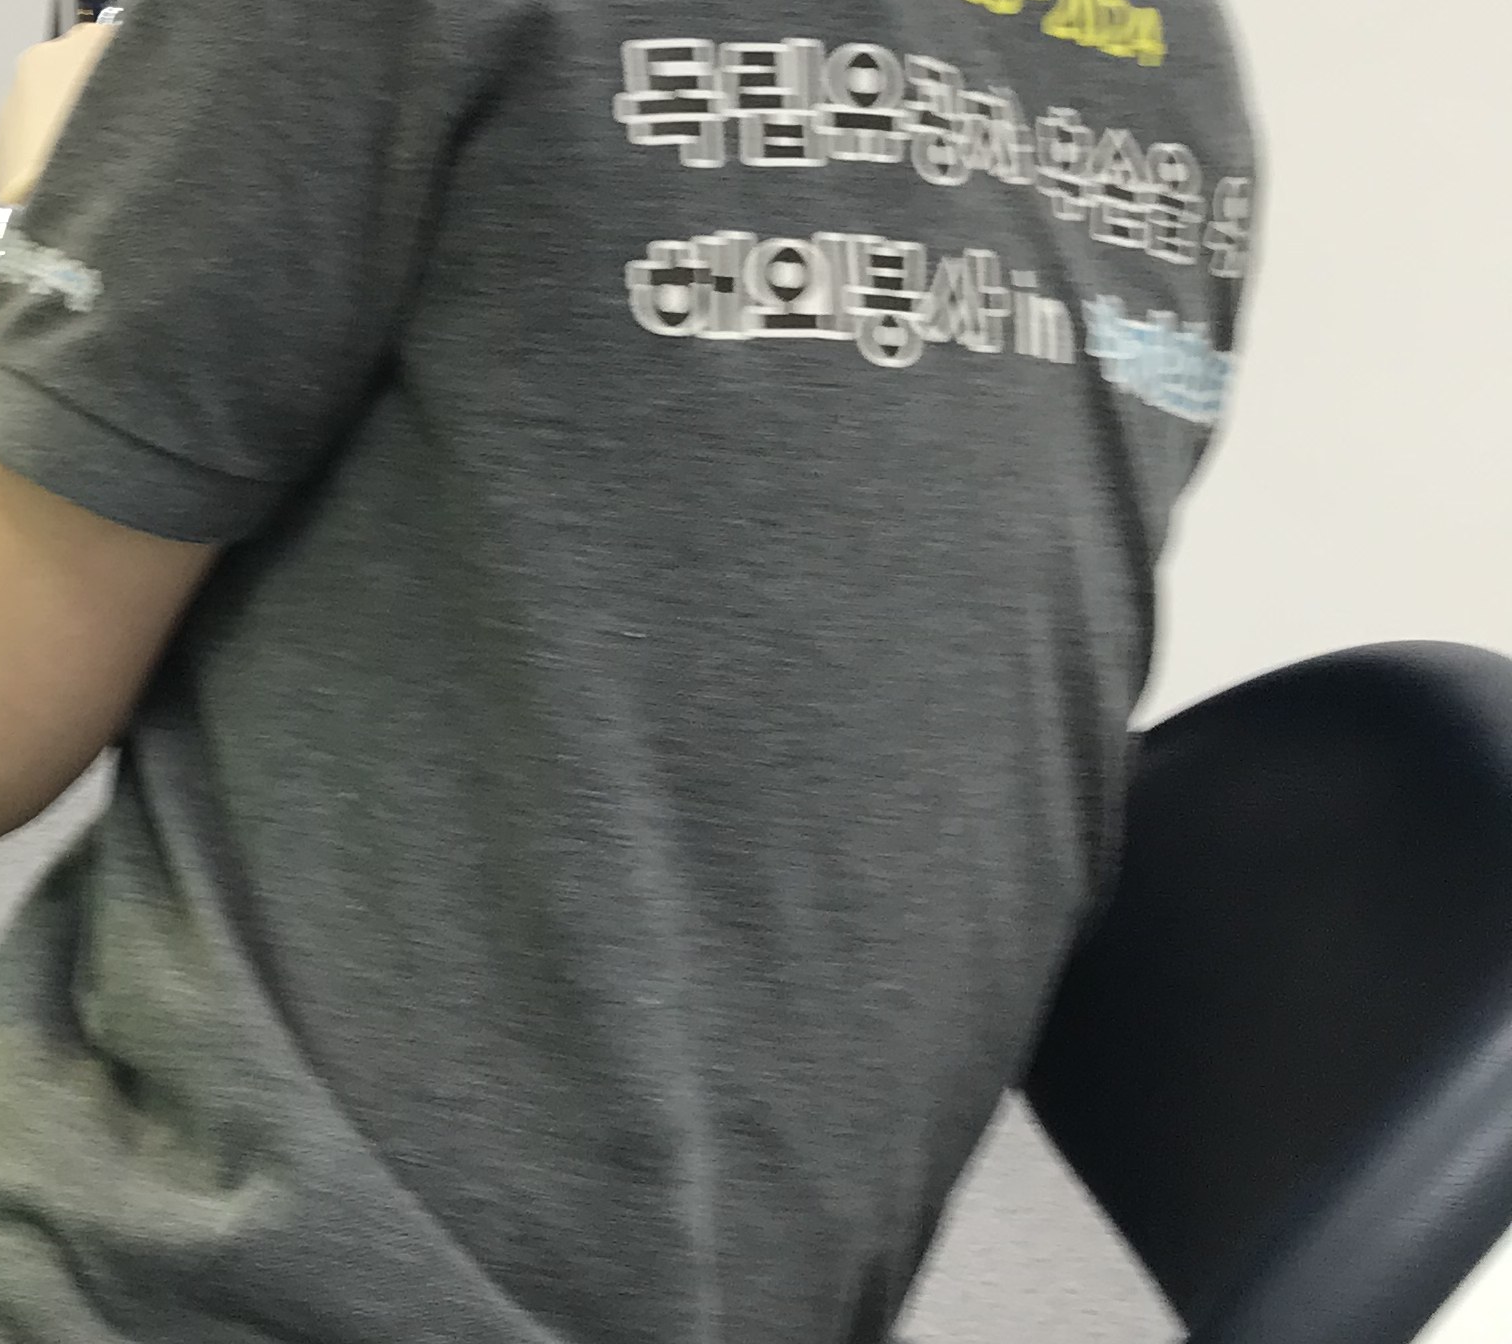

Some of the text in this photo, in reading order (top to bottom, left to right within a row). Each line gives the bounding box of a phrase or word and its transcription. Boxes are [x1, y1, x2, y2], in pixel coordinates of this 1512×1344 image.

[613, 37, 1035, 187] 독립유공자
[625, 230, 1009, 368] 해외봉사
[1010, 269, 1076, 363] in
